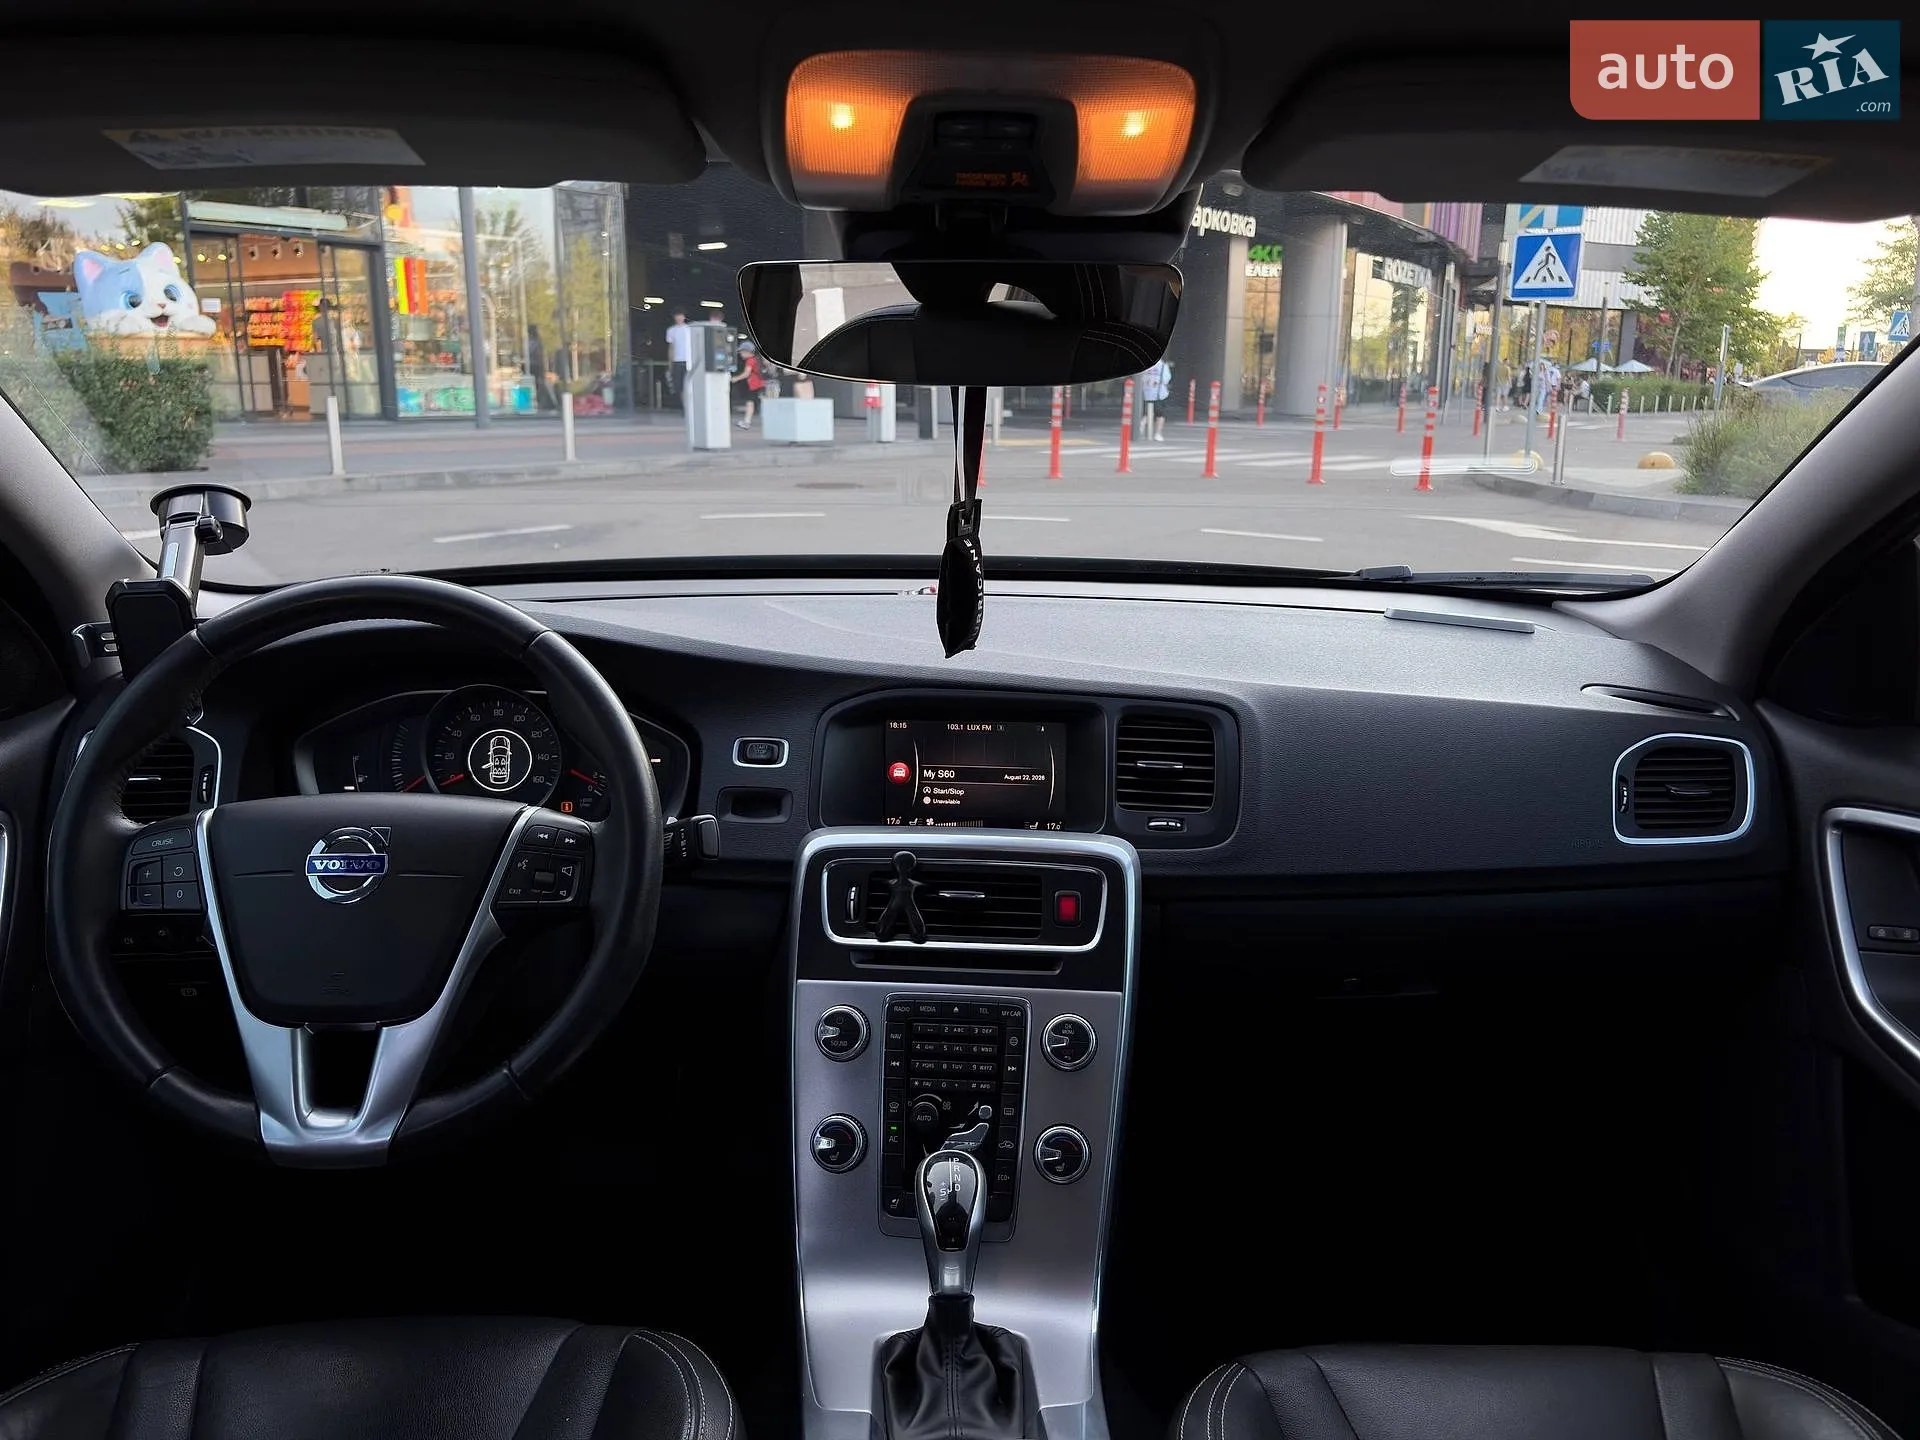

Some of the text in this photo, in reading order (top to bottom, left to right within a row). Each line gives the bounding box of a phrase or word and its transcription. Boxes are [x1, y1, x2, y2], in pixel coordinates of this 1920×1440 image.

[1192, 205, 1256, 238] арковка
[493, 709, 504, 717] 80
[470, 714, 481, 722] 60
[513, 714, 526, 722] 100
[530, 730, 543, 738] 120
[444, 752, 455, 760] 20
[537, 753, 550, 761] 140
[923, 770, 955, 780] My S60
[532, 776, 545, 784] 160
[151, 837, 174, 847] CRUISE
[312, 860, 381, 870] VOLVO
[954, 1174, 961, 1182] N
[954, 1183, 961, 1192] D
[939, 1189, 947, 1197] S
